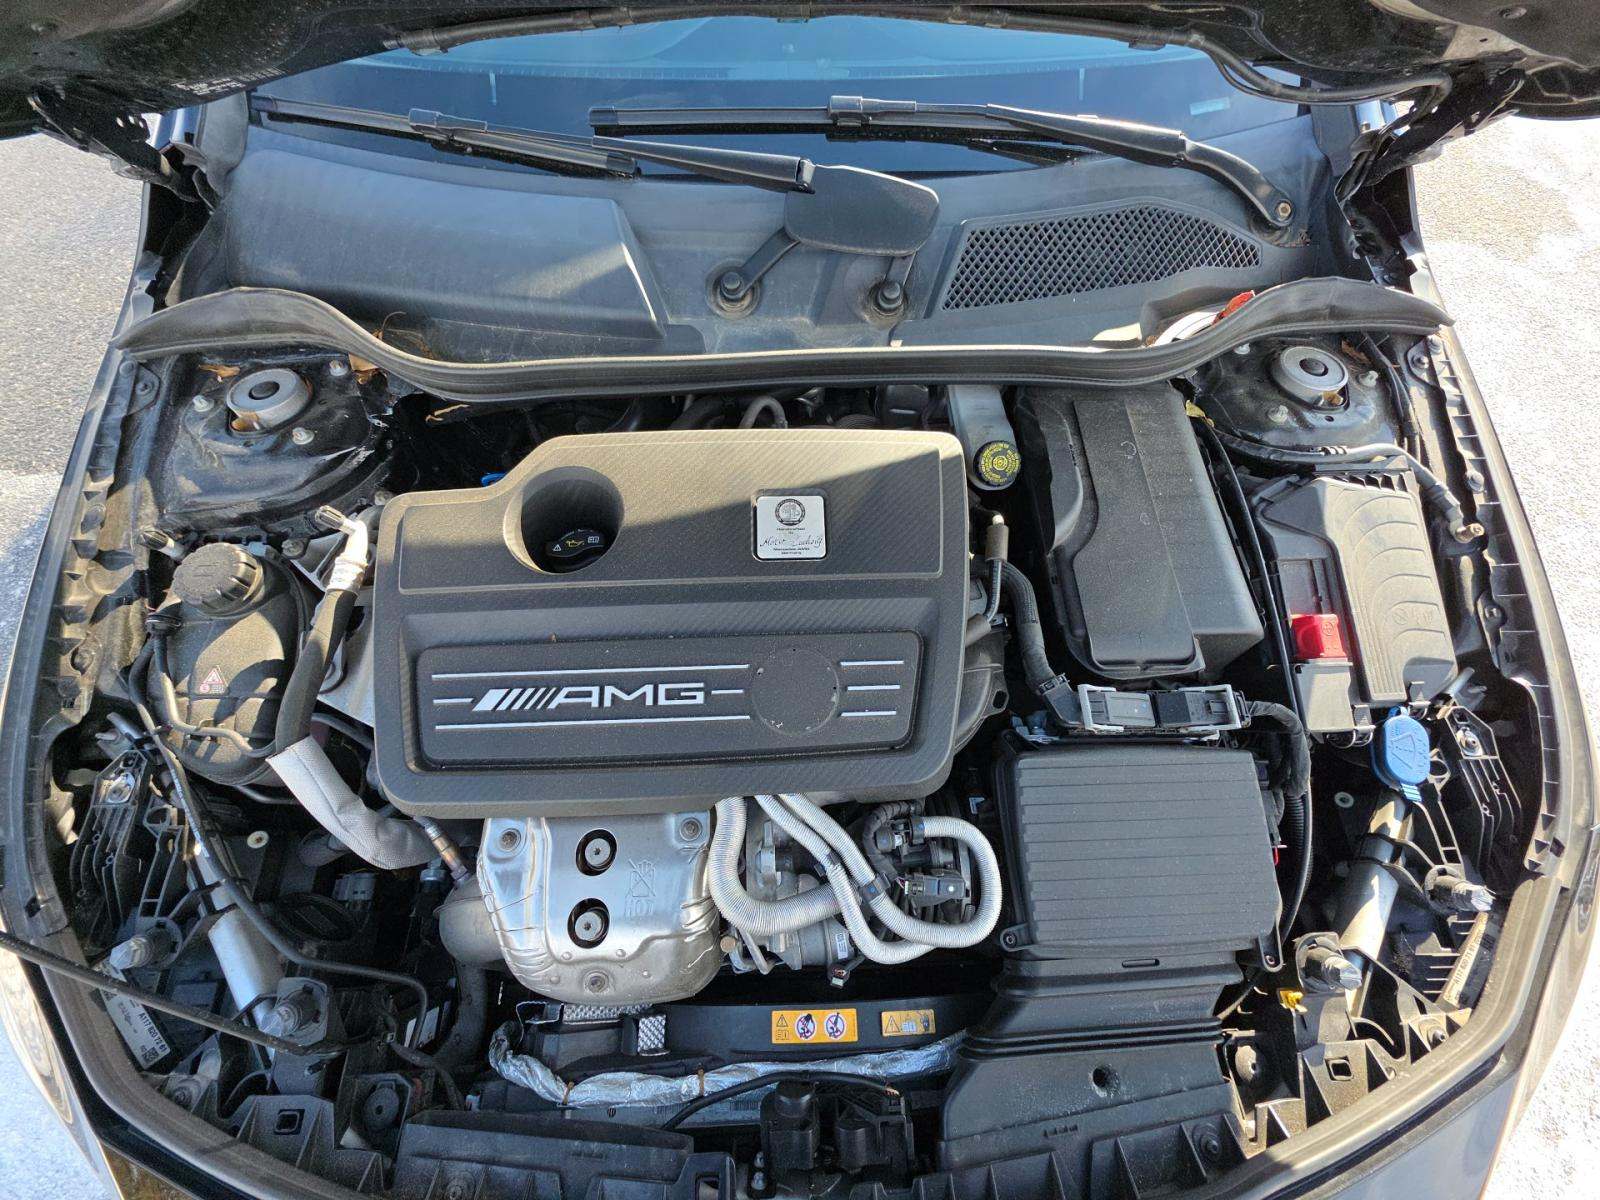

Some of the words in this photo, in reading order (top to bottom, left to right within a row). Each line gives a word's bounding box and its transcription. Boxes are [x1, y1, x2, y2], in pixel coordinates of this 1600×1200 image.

[547, 682, 704, 711] AMG
[624, 898, 656, 920] HOT
[138, 1012, 152, 1028] A117
